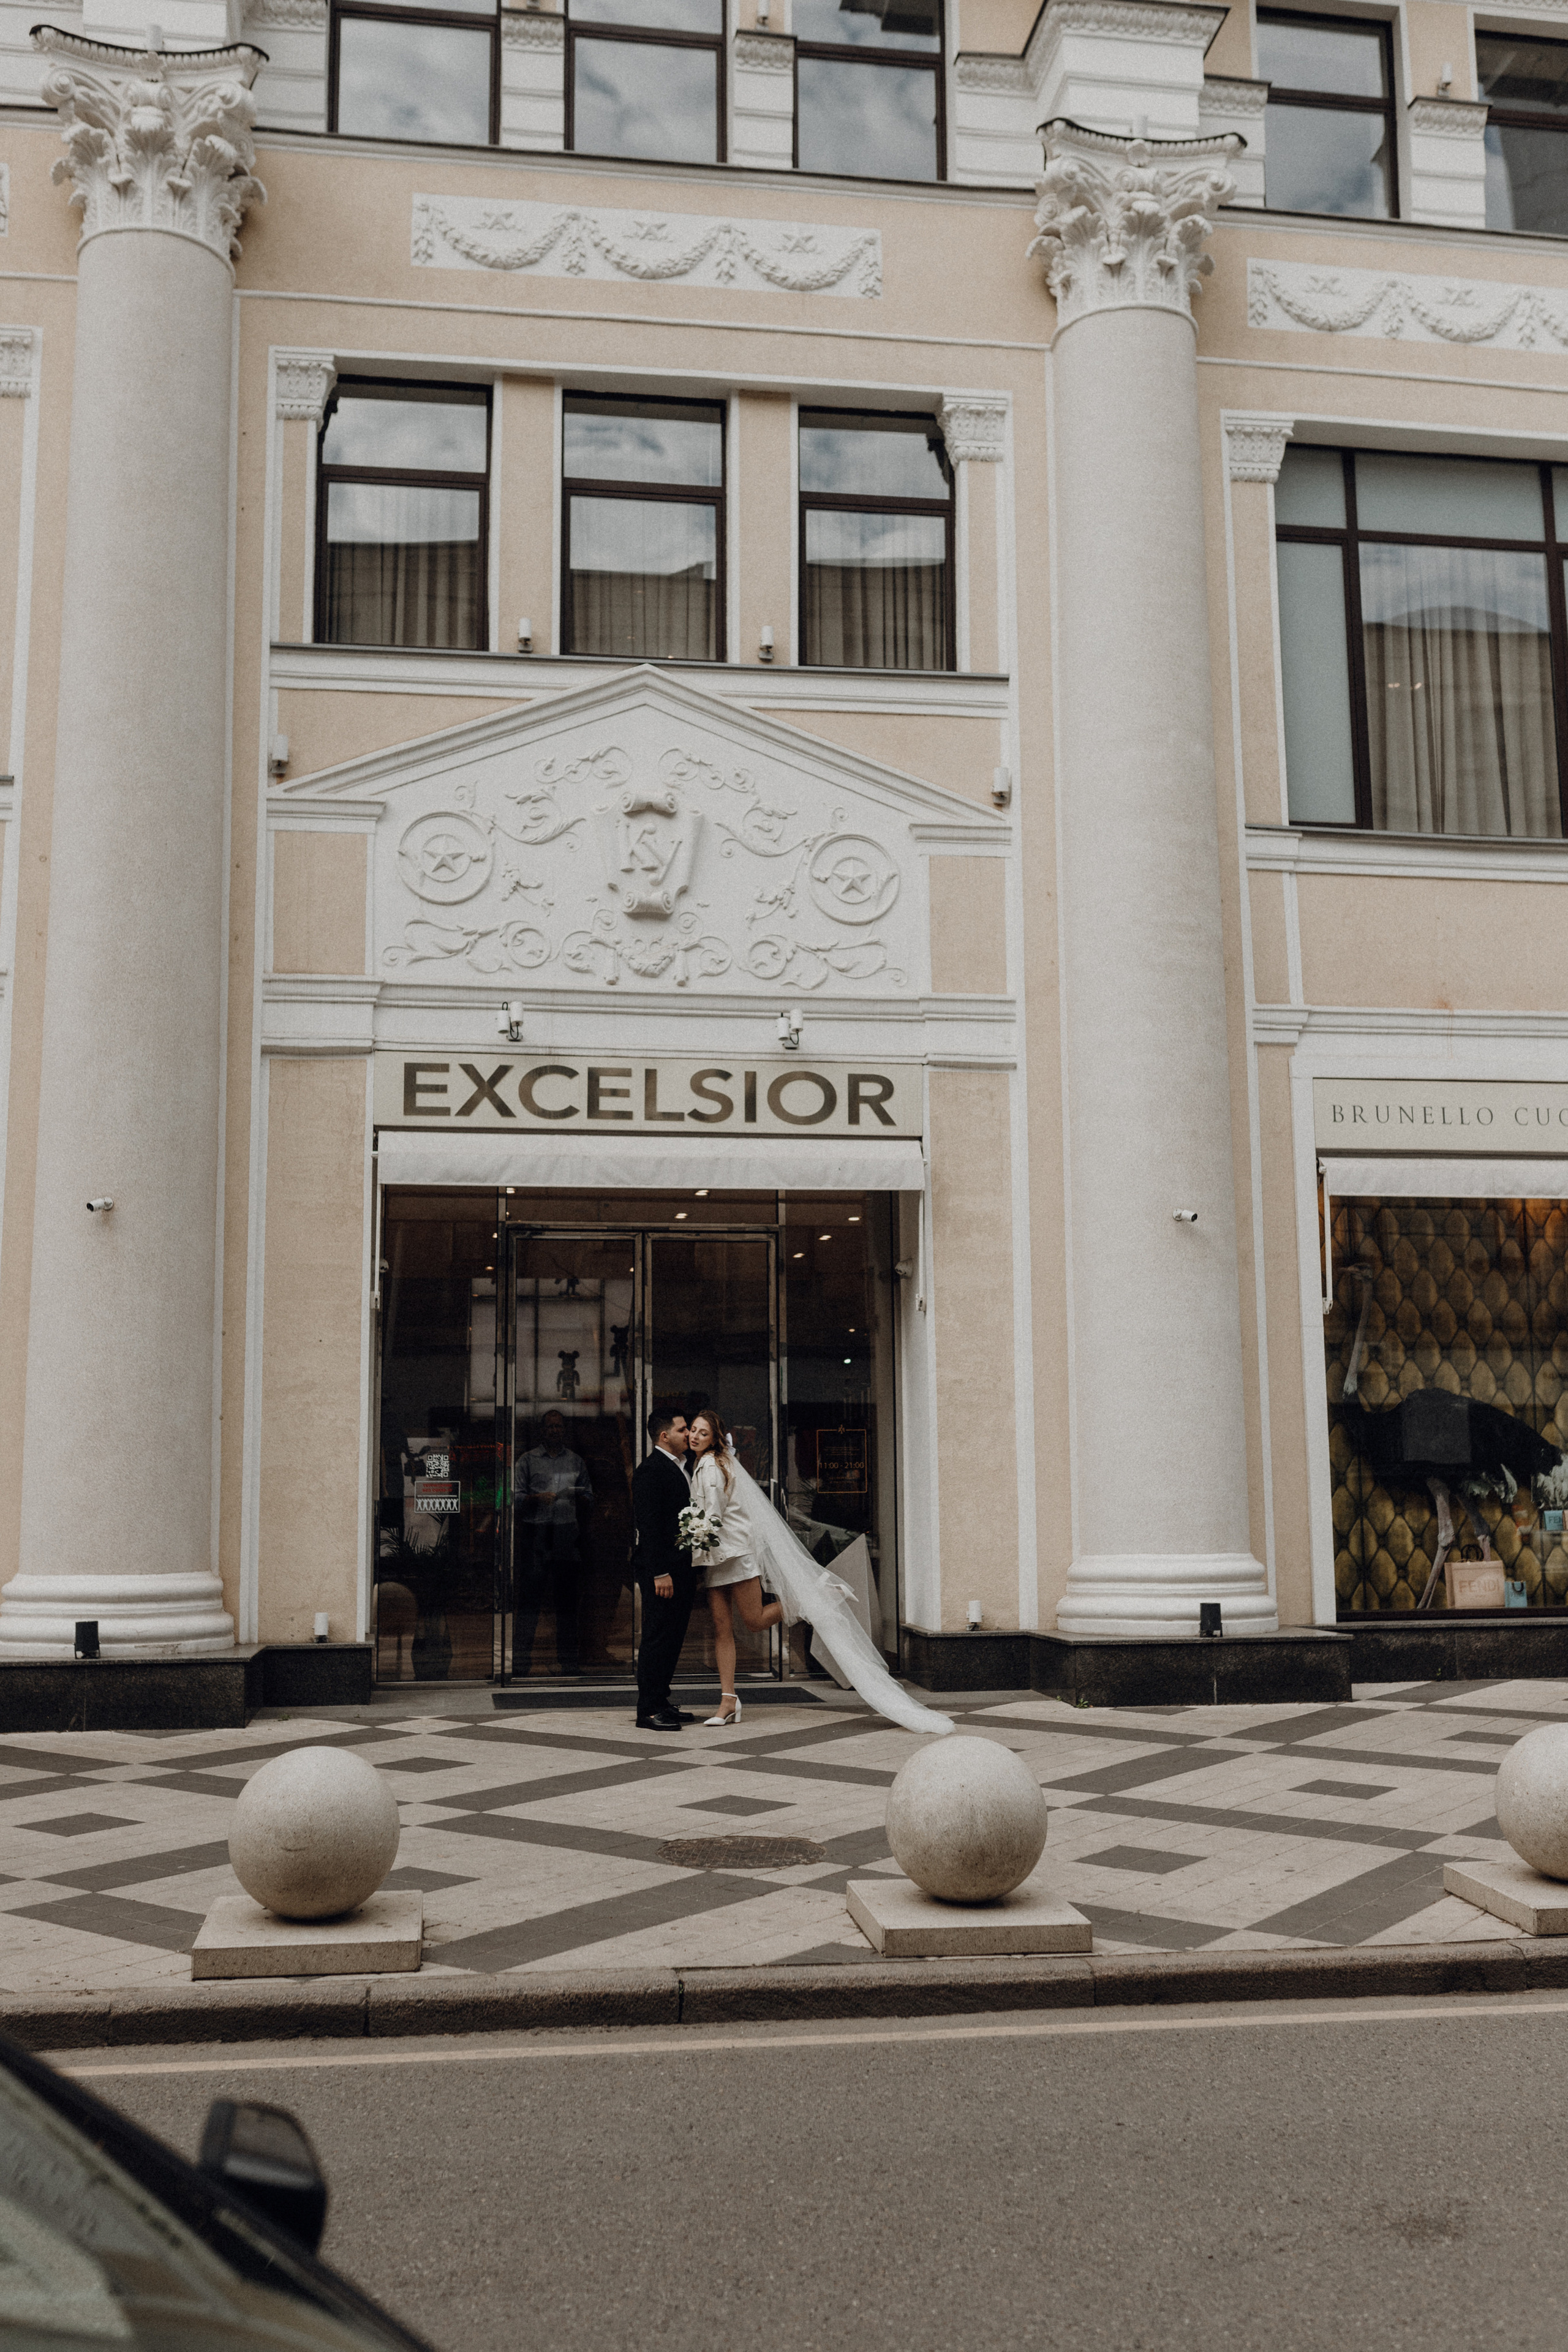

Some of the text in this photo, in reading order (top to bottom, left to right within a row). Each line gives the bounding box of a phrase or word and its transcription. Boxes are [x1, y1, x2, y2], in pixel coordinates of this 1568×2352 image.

[402, 1062, 897, 1126] EXCELSIOR
[1332, 1104, 1568, 1126] BRUNELLO CUC
[1458, 1578, 1500, 1593] FENDI
